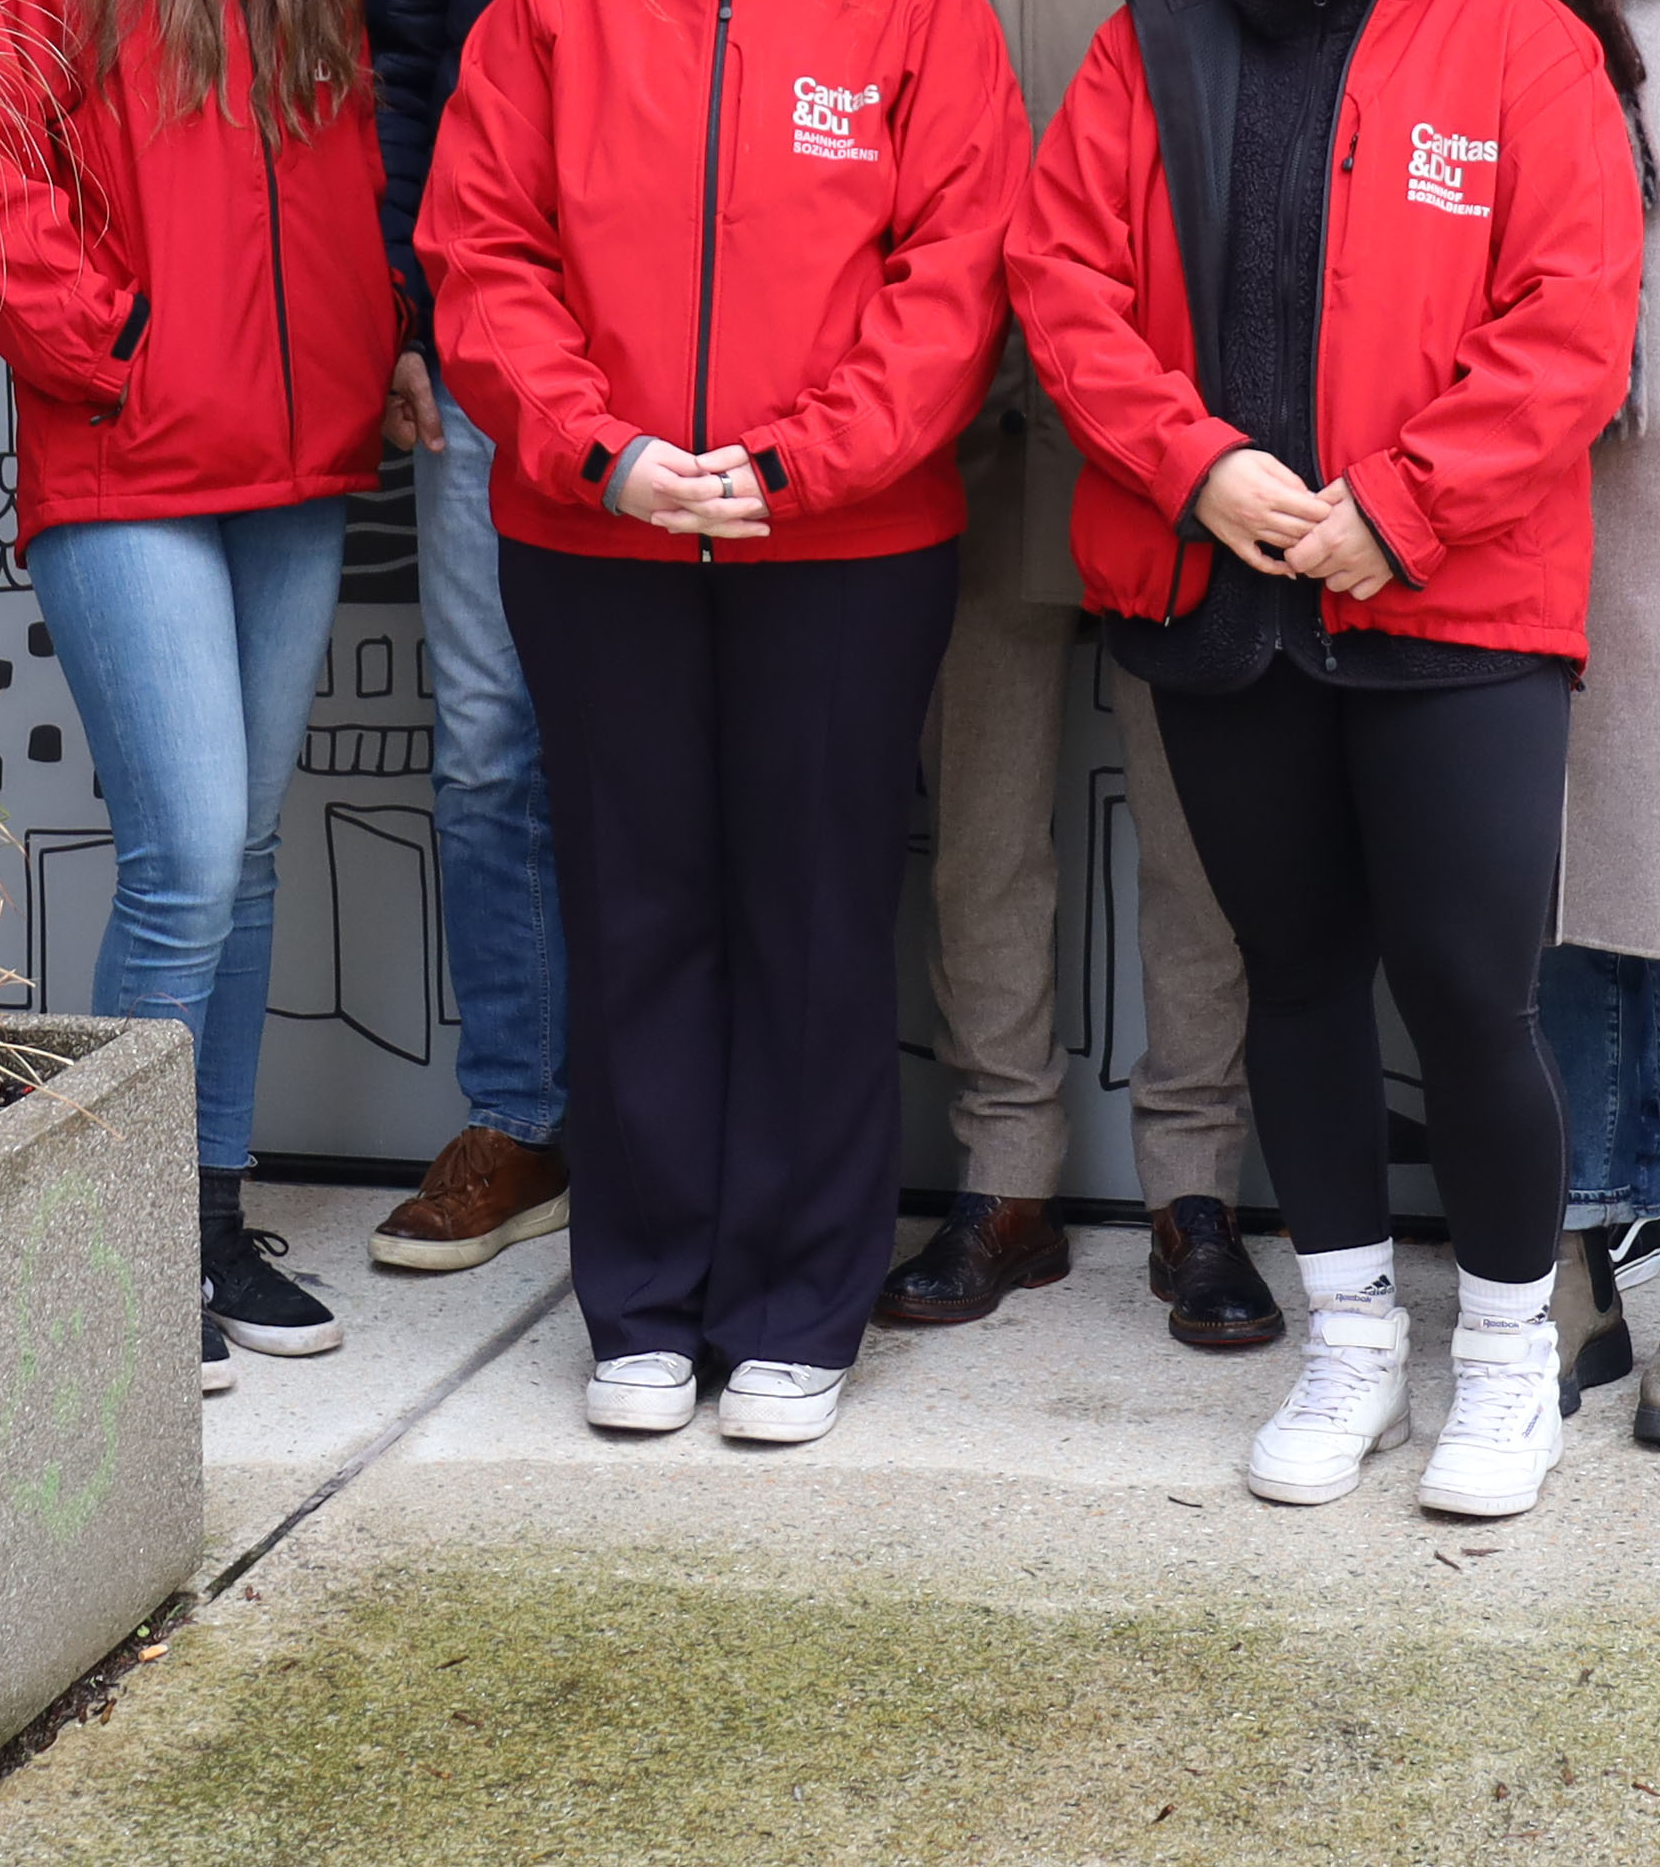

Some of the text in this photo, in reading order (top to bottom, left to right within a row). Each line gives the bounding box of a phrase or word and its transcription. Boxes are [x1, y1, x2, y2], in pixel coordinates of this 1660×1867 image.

[793, 76, 880, 113] Caritas
[792, 100, 849, 136] &Du
[793, 141, 879, 162] SOZIALDIENST
[794, 129, 855, 149] BAHNHOF
[1411, 122, 1499, 163] Caritas
[1408, 149, 1462, 188] &Du
[1407, 190, 1491, 218] SOZIALDIENST
[1408, 178, 1464, 203] BAHNHOF
